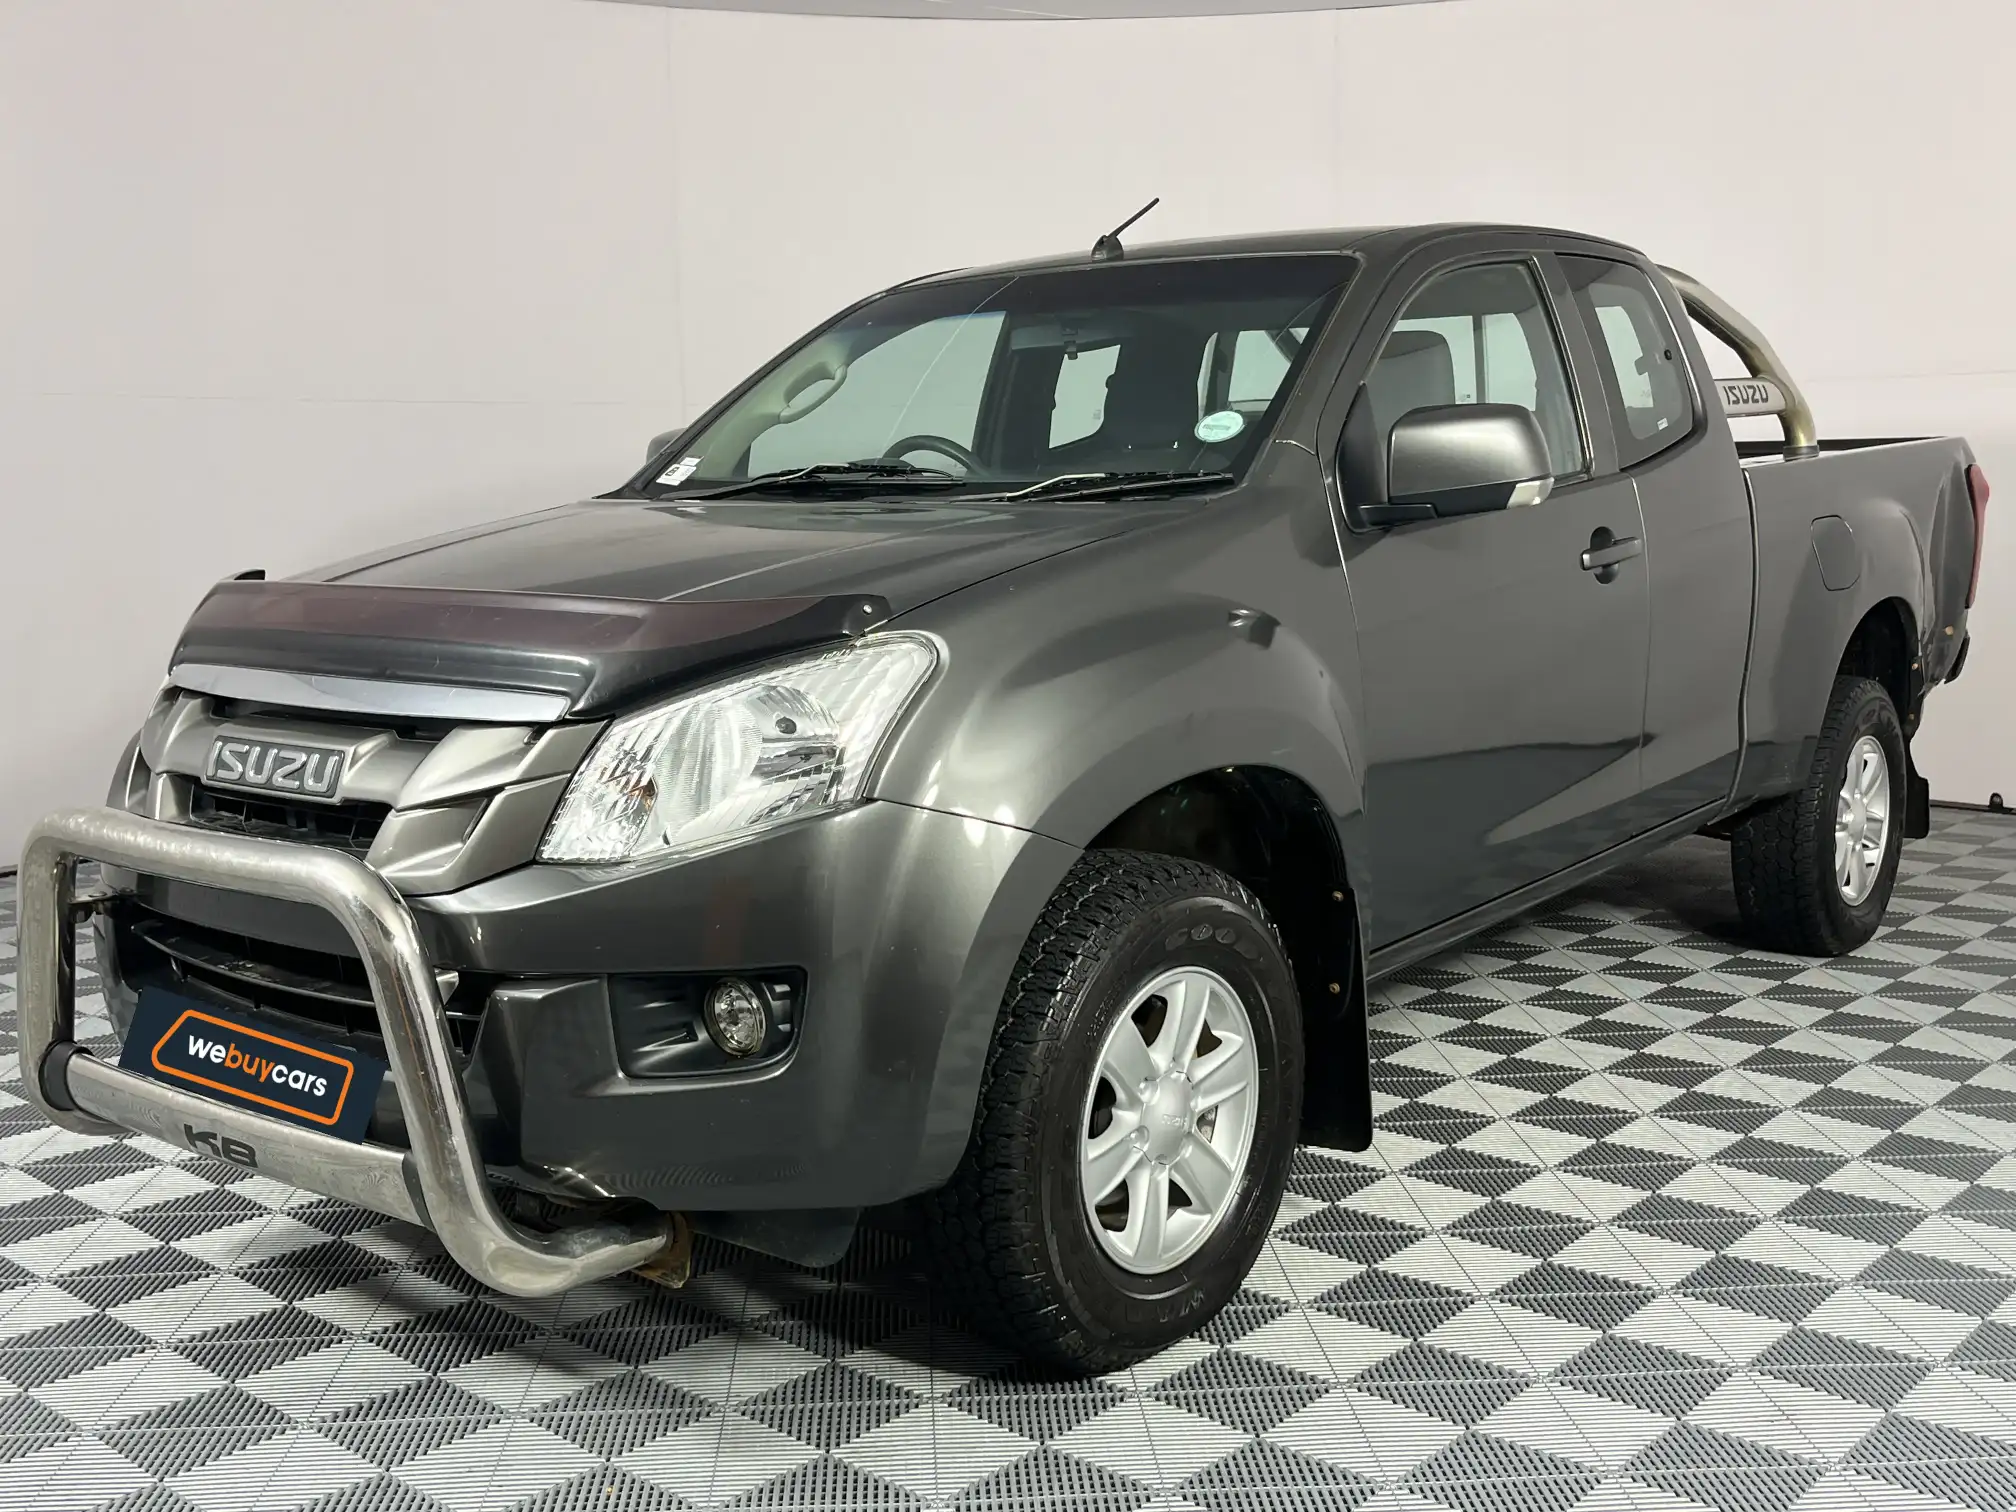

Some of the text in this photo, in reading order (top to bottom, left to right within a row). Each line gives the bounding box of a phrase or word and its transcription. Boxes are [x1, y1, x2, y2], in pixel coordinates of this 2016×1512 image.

[1723, 384, 1769, 405] ISUZU
[206, 740, 339, 793] ISUZU
[188, 1035, 328, 1097] webuycars
